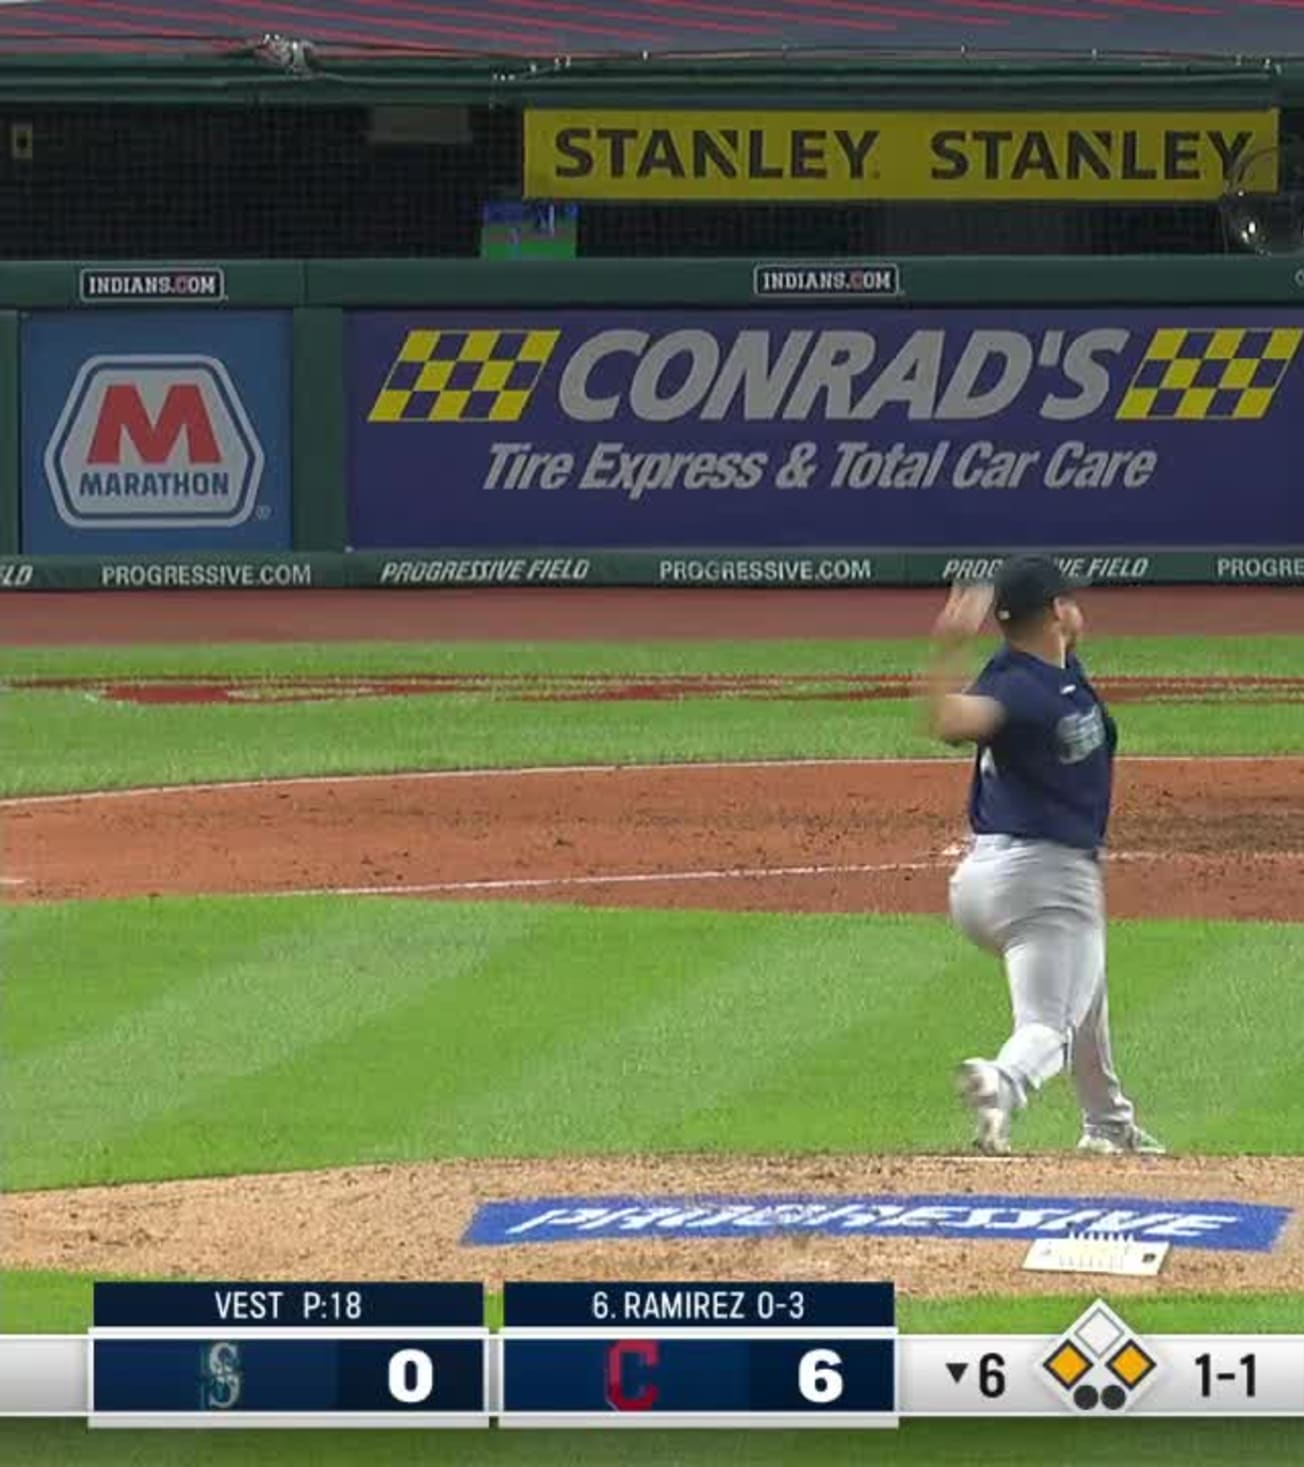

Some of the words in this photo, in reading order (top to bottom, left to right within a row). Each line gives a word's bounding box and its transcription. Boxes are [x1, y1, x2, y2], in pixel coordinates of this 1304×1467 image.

[555, 128, 880, 180] STANLEY
[930, 130, 1254, 181] STANLEY
[88, 275, 216, 295] INDIANS.COM
[762, 269, 892, 290] INDIANS.COM
[559, 328, 1130, 422] CONRAD'S
[482, 443, 572, 489] Tire
[579, 441, 768, 499] Express
[776, 442, 817, 488] &
[830, 441, 943, 488] Total
[951, 441, 1040, 488] Car
[1044, 441, 1157, 488] Care
[79, 472, 229, 497] MARATHON
[101, 564, 312, 586] PROGRESSIVE.COM
[380, 561, 520, 583] PROGRESSIVE
[525, 559, 590, 581] FIELD
[659, 560, 872, 582] PROGRESSIVE.COM
[1086, 557, 1150, 578] FIELD
